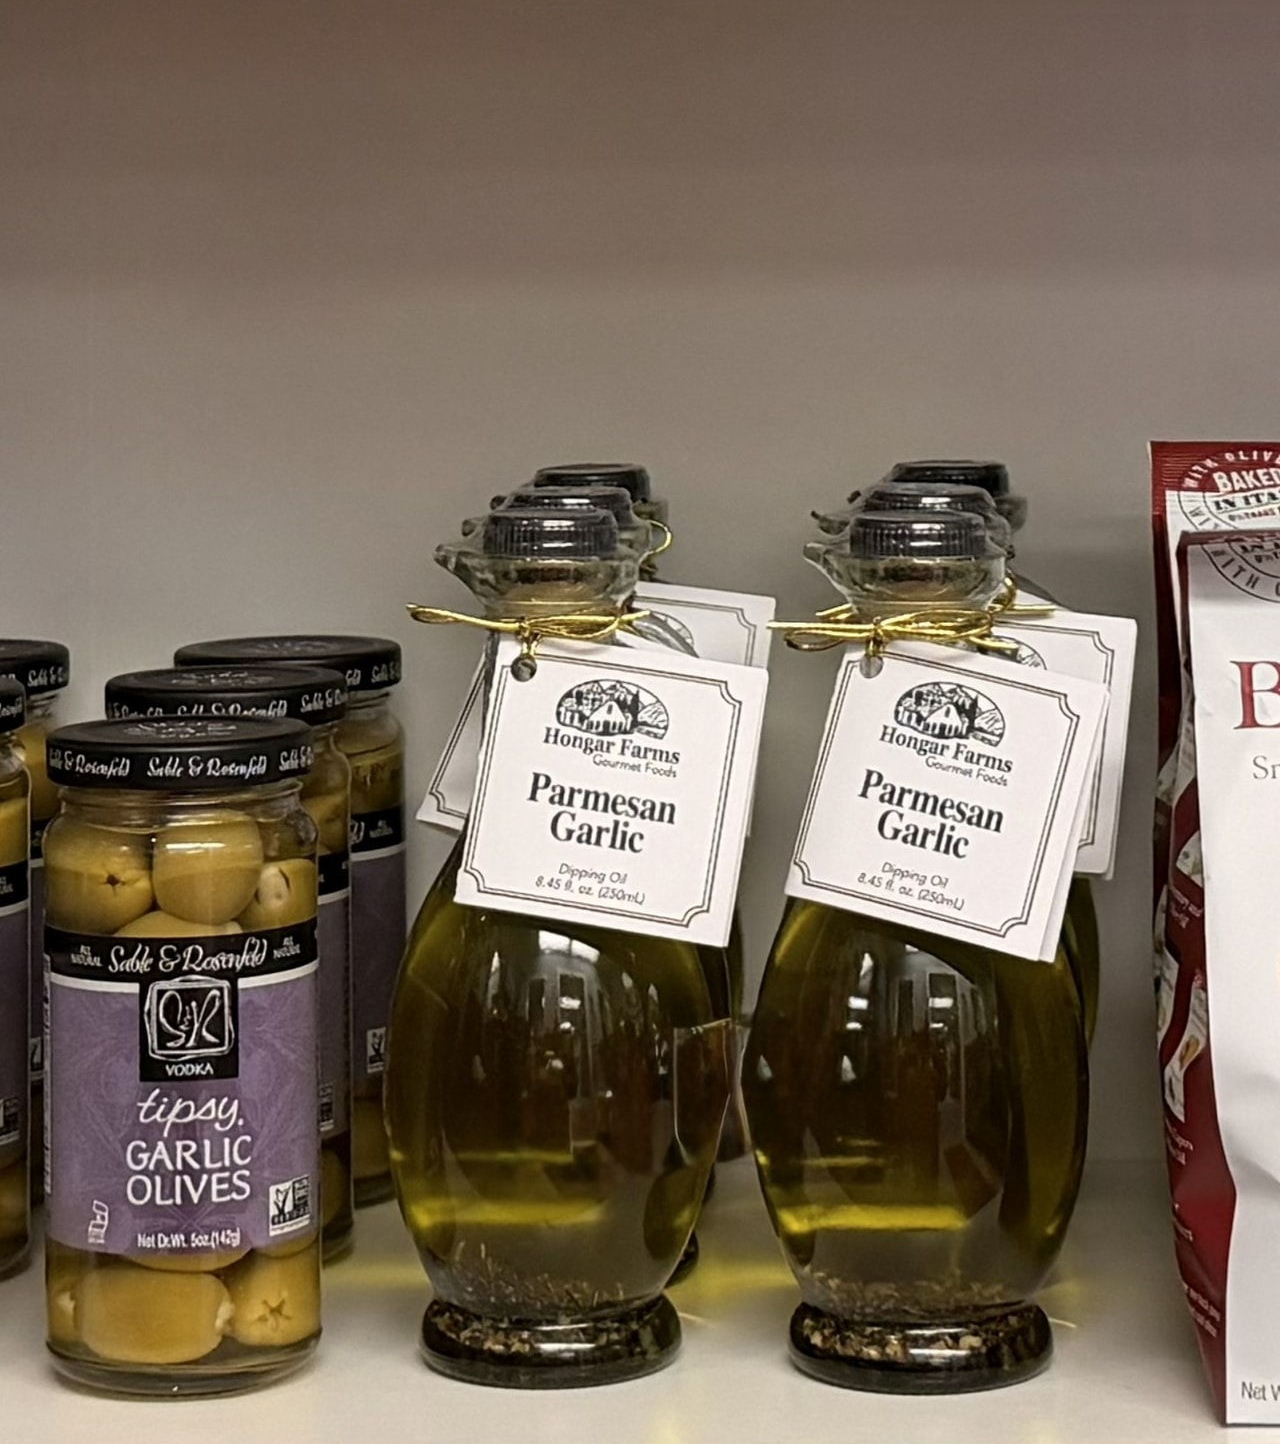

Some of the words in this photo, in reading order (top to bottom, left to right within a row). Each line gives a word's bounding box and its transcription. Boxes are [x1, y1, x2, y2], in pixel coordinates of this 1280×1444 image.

[542, 727, 615, 755] Hongar
[619, 738, 680, 764] Farms
[592, 754, 641, 773] Gourmet
[645, 760, 678, 778] Foods
[527, 771, 676, 825] Parmesan
[858, 769, 1004, 833] Parmesan
[550, 811, 645, 853] Garlic
[877, 809, 970, 858] Garlic
[881, 862, 927, 885] Dipping
[931, 872, 949, 887] Oil
[108, 947, 152, 974] Sable
[158, 948, 180, 974] &
[181, 940, 269, 972] Rosenfeld
[165, 1062, 215, 1076] VODKA
[125, 1136, 252, 1171] GARLIC
[125, 1170, 251, 1206] OLIVES
[1240, 1383, 1266, 1403] Net
